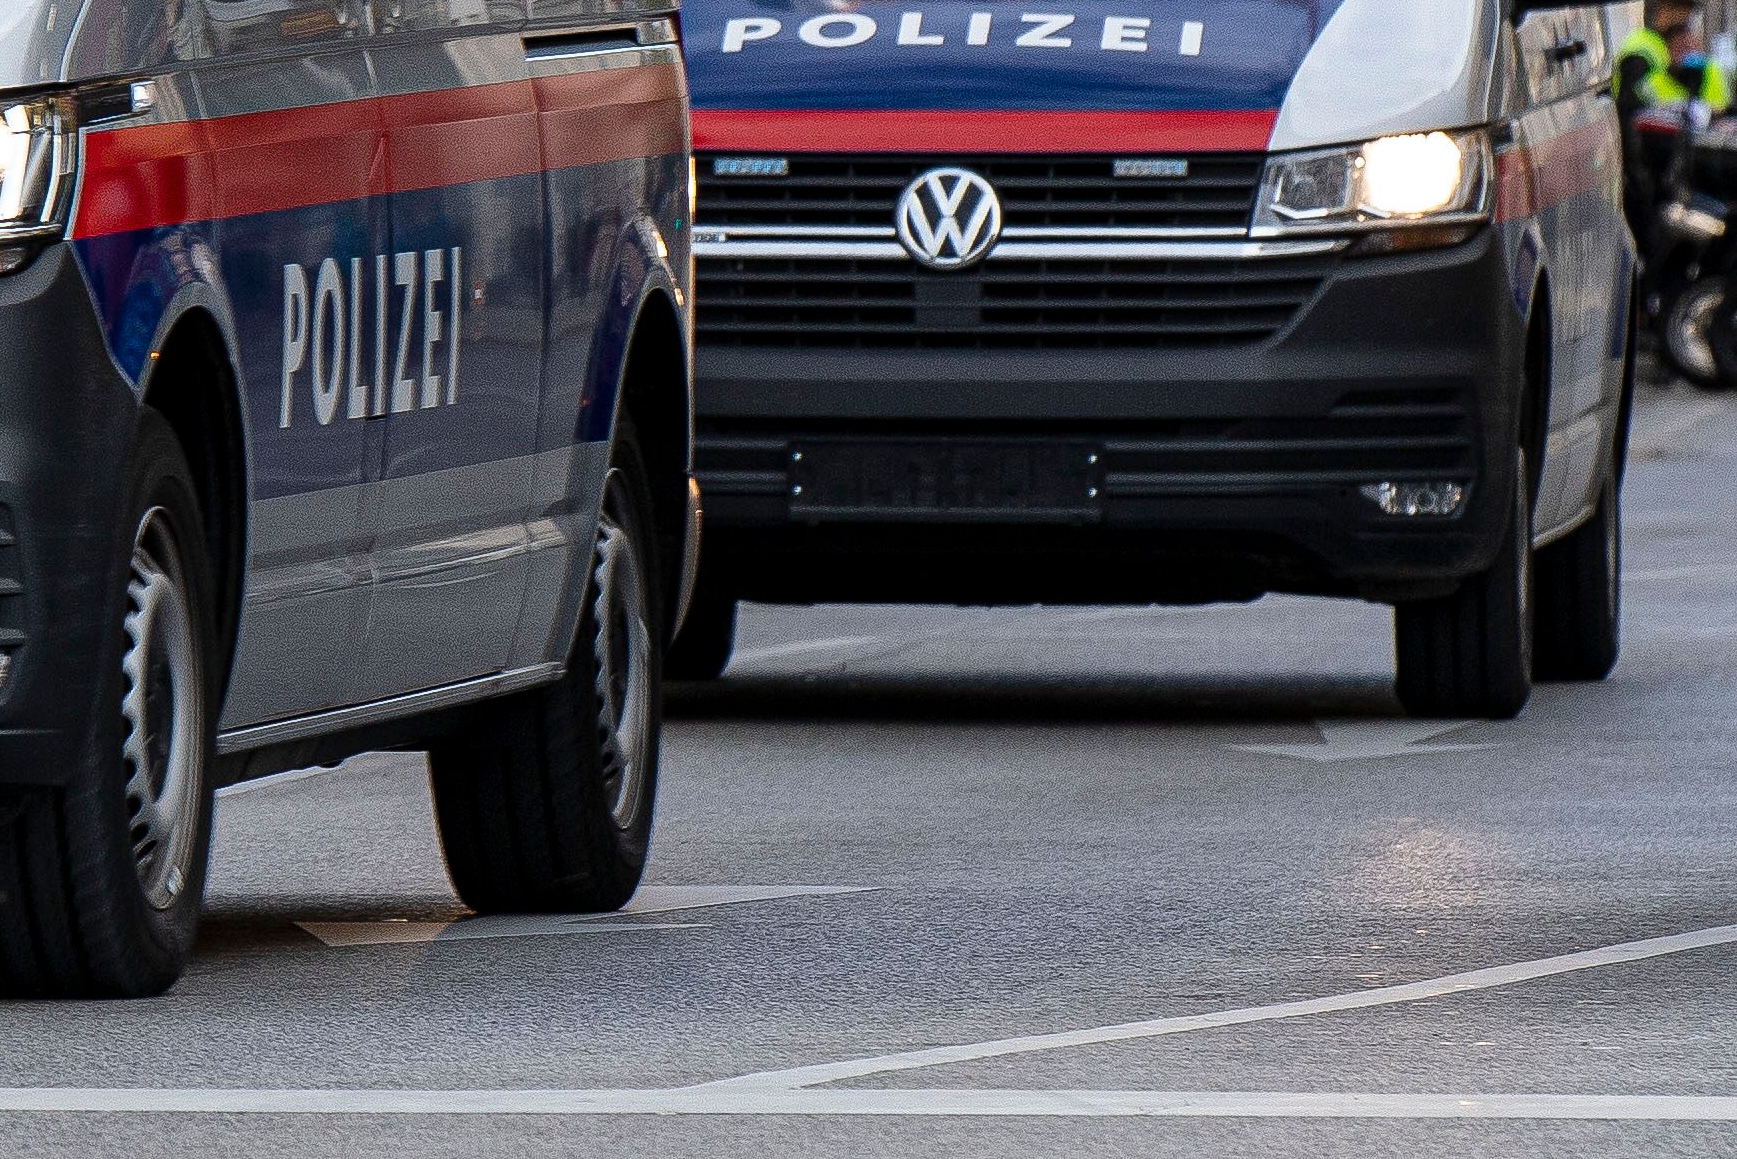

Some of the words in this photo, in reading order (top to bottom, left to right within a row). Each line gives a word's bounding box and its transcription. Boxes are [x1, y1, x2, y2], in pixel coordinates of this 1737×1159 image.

[722, 12, 1204, 56] POLIZEI
[900, 171, 997, 263] VW
[279, 247, 462, 428] POLIZEI
